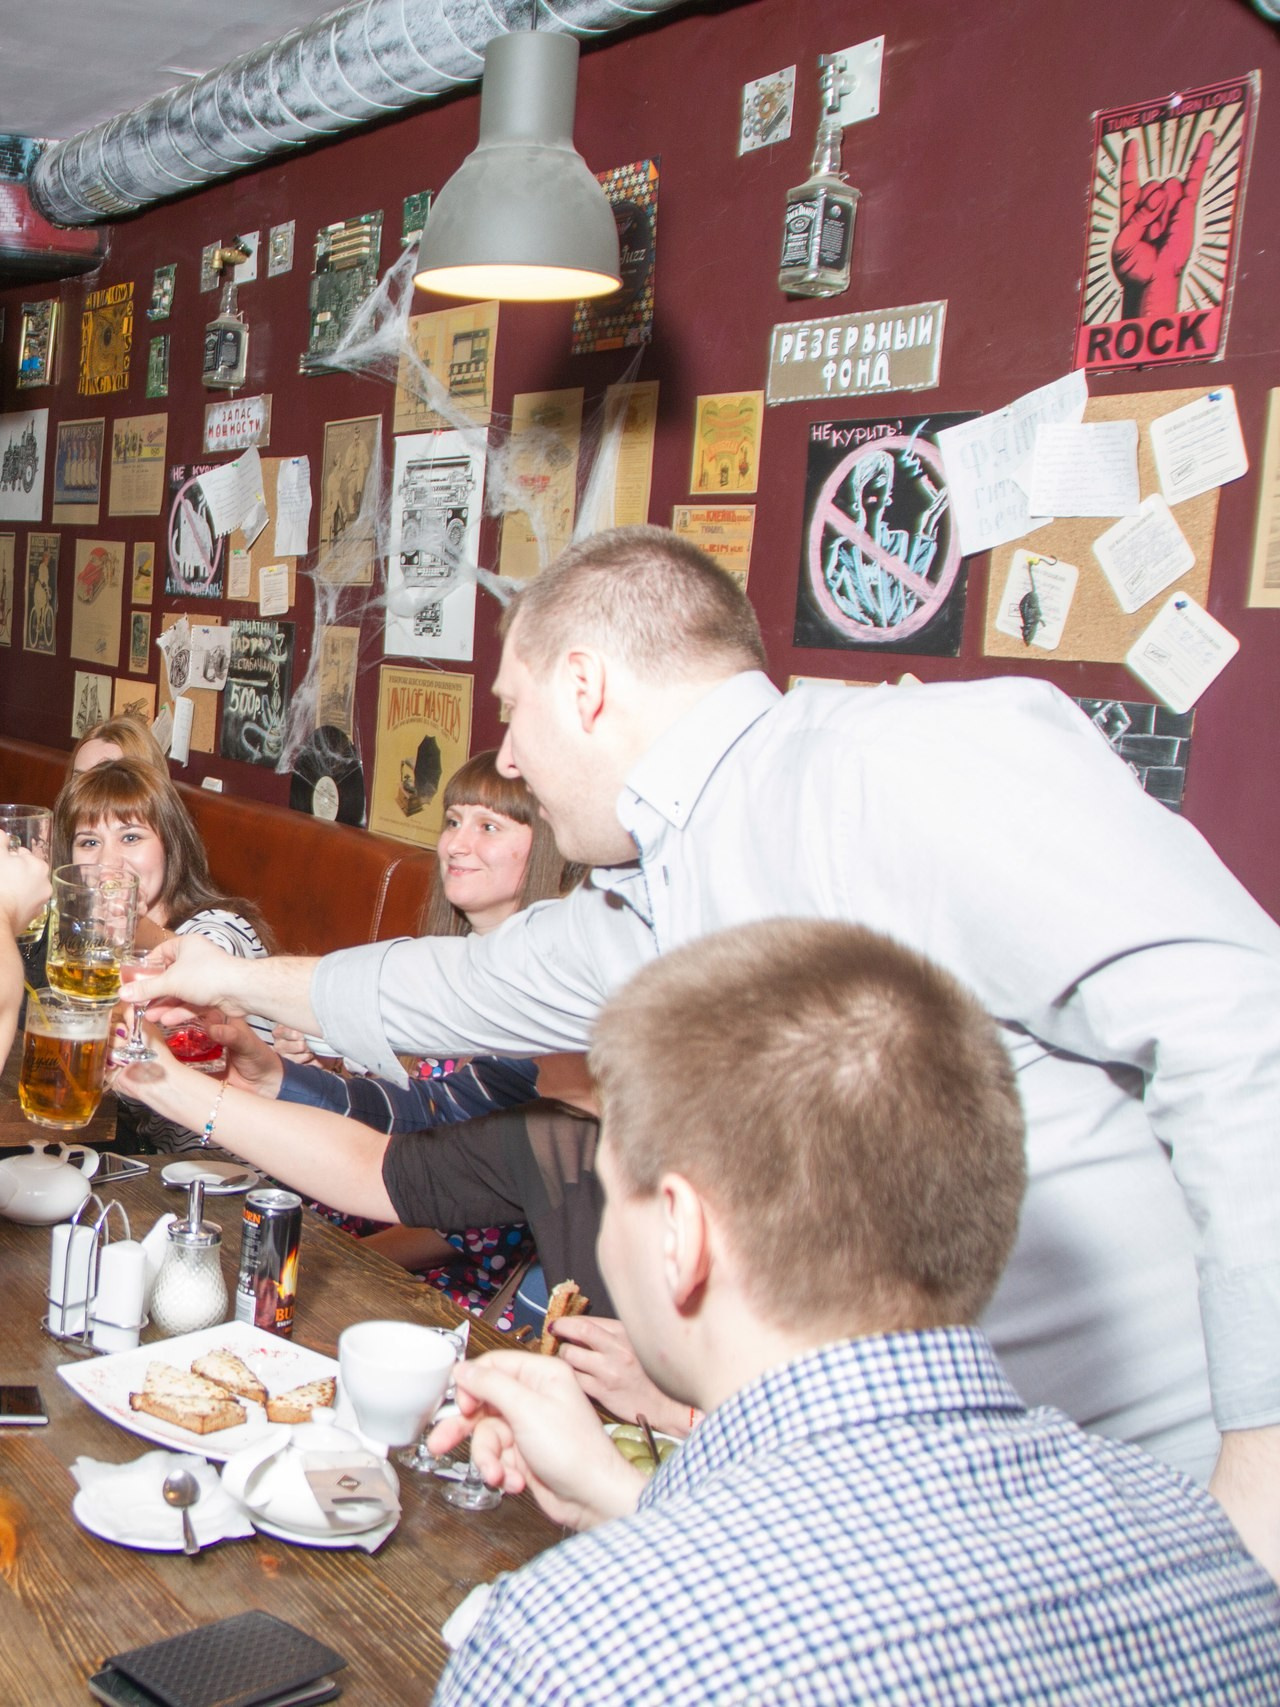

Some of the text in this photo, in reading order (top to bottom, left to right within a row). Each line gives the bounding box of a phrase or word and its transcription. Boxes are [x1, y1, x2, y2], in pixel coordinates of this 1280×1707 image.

[1108, 88, 1243, 131] TUNE UP TURN LOUD
[780, 309, 934, 365] РЕЗЕРВНЫЙ
[1086, 312, 1212, 363] ROCK
[822, 351, 891, 391] ФОНД
[222, 407, 251, 422] ЗАПАС
[812, 420, 903, 447] НЕ КУРИТЬ!
[173, 466, 185, 481] НЕ
[387, 686, 423, 731] VINTAGE
[423, 689, 462, 744] MASTERS
